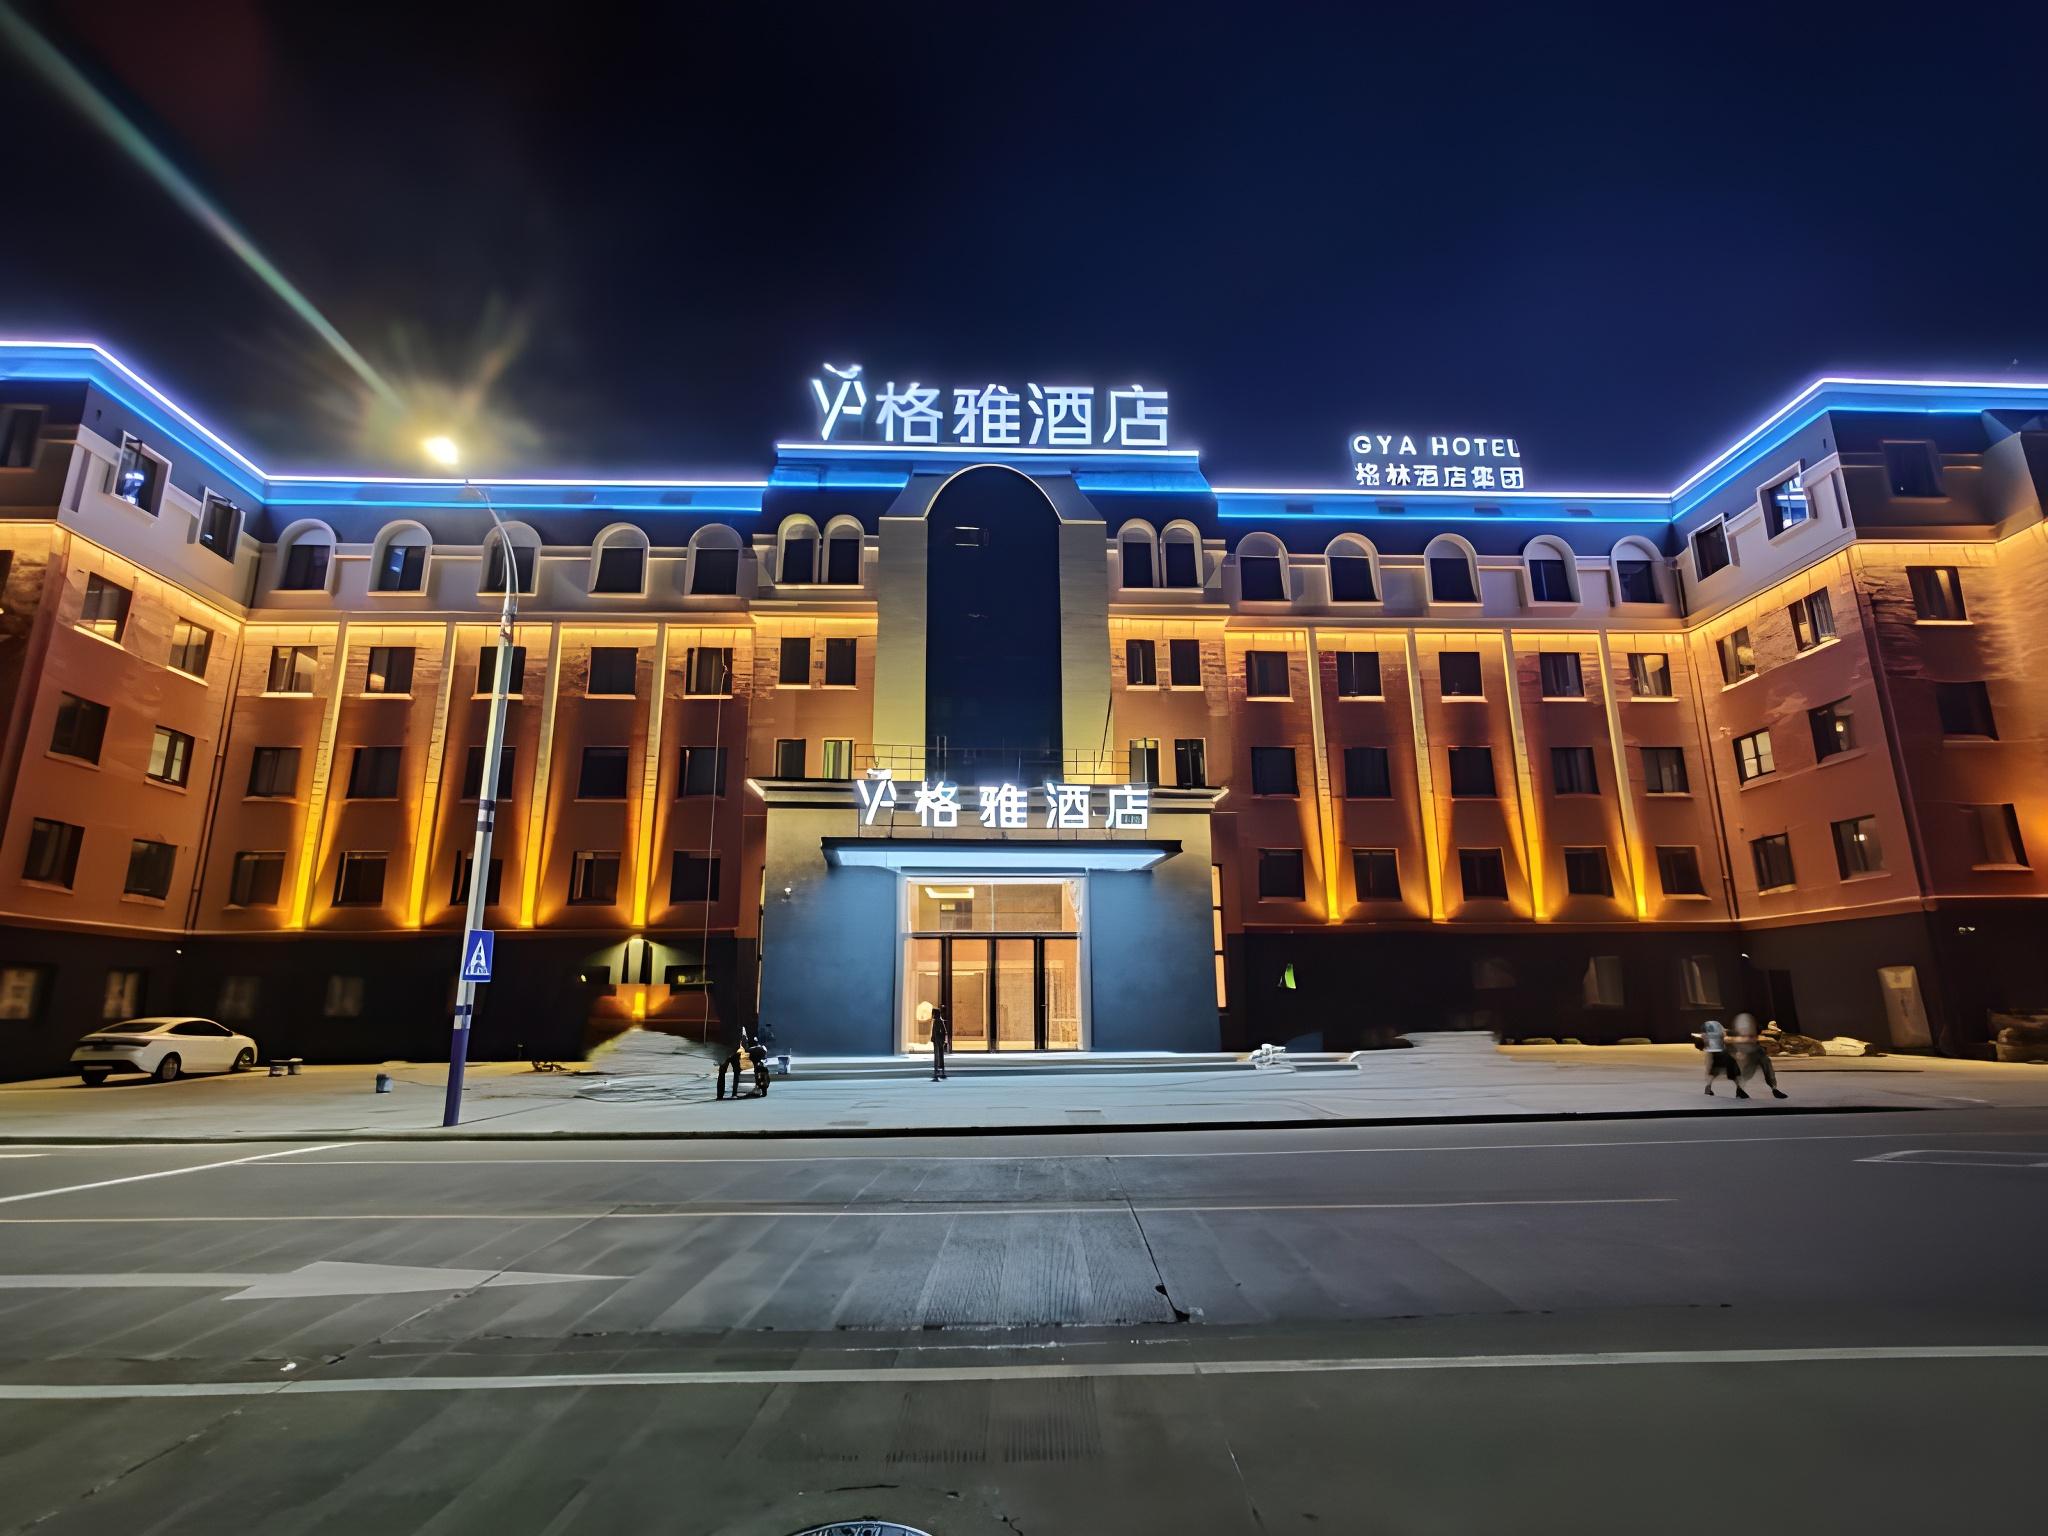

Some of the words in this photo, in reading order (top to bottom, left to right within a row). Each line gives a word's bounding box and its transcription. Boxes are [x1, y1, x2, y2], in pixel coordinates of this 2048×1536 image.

[876, 382, 1169, 446] 格雅酒店
[1353, 435, 1417, 455] GYA
[1431, 436, 1521, 458] HOTEL
[1354, 462, 1524, 489] 格林酒店集团
[914, 781, 1150, 831] 格雅酒店
